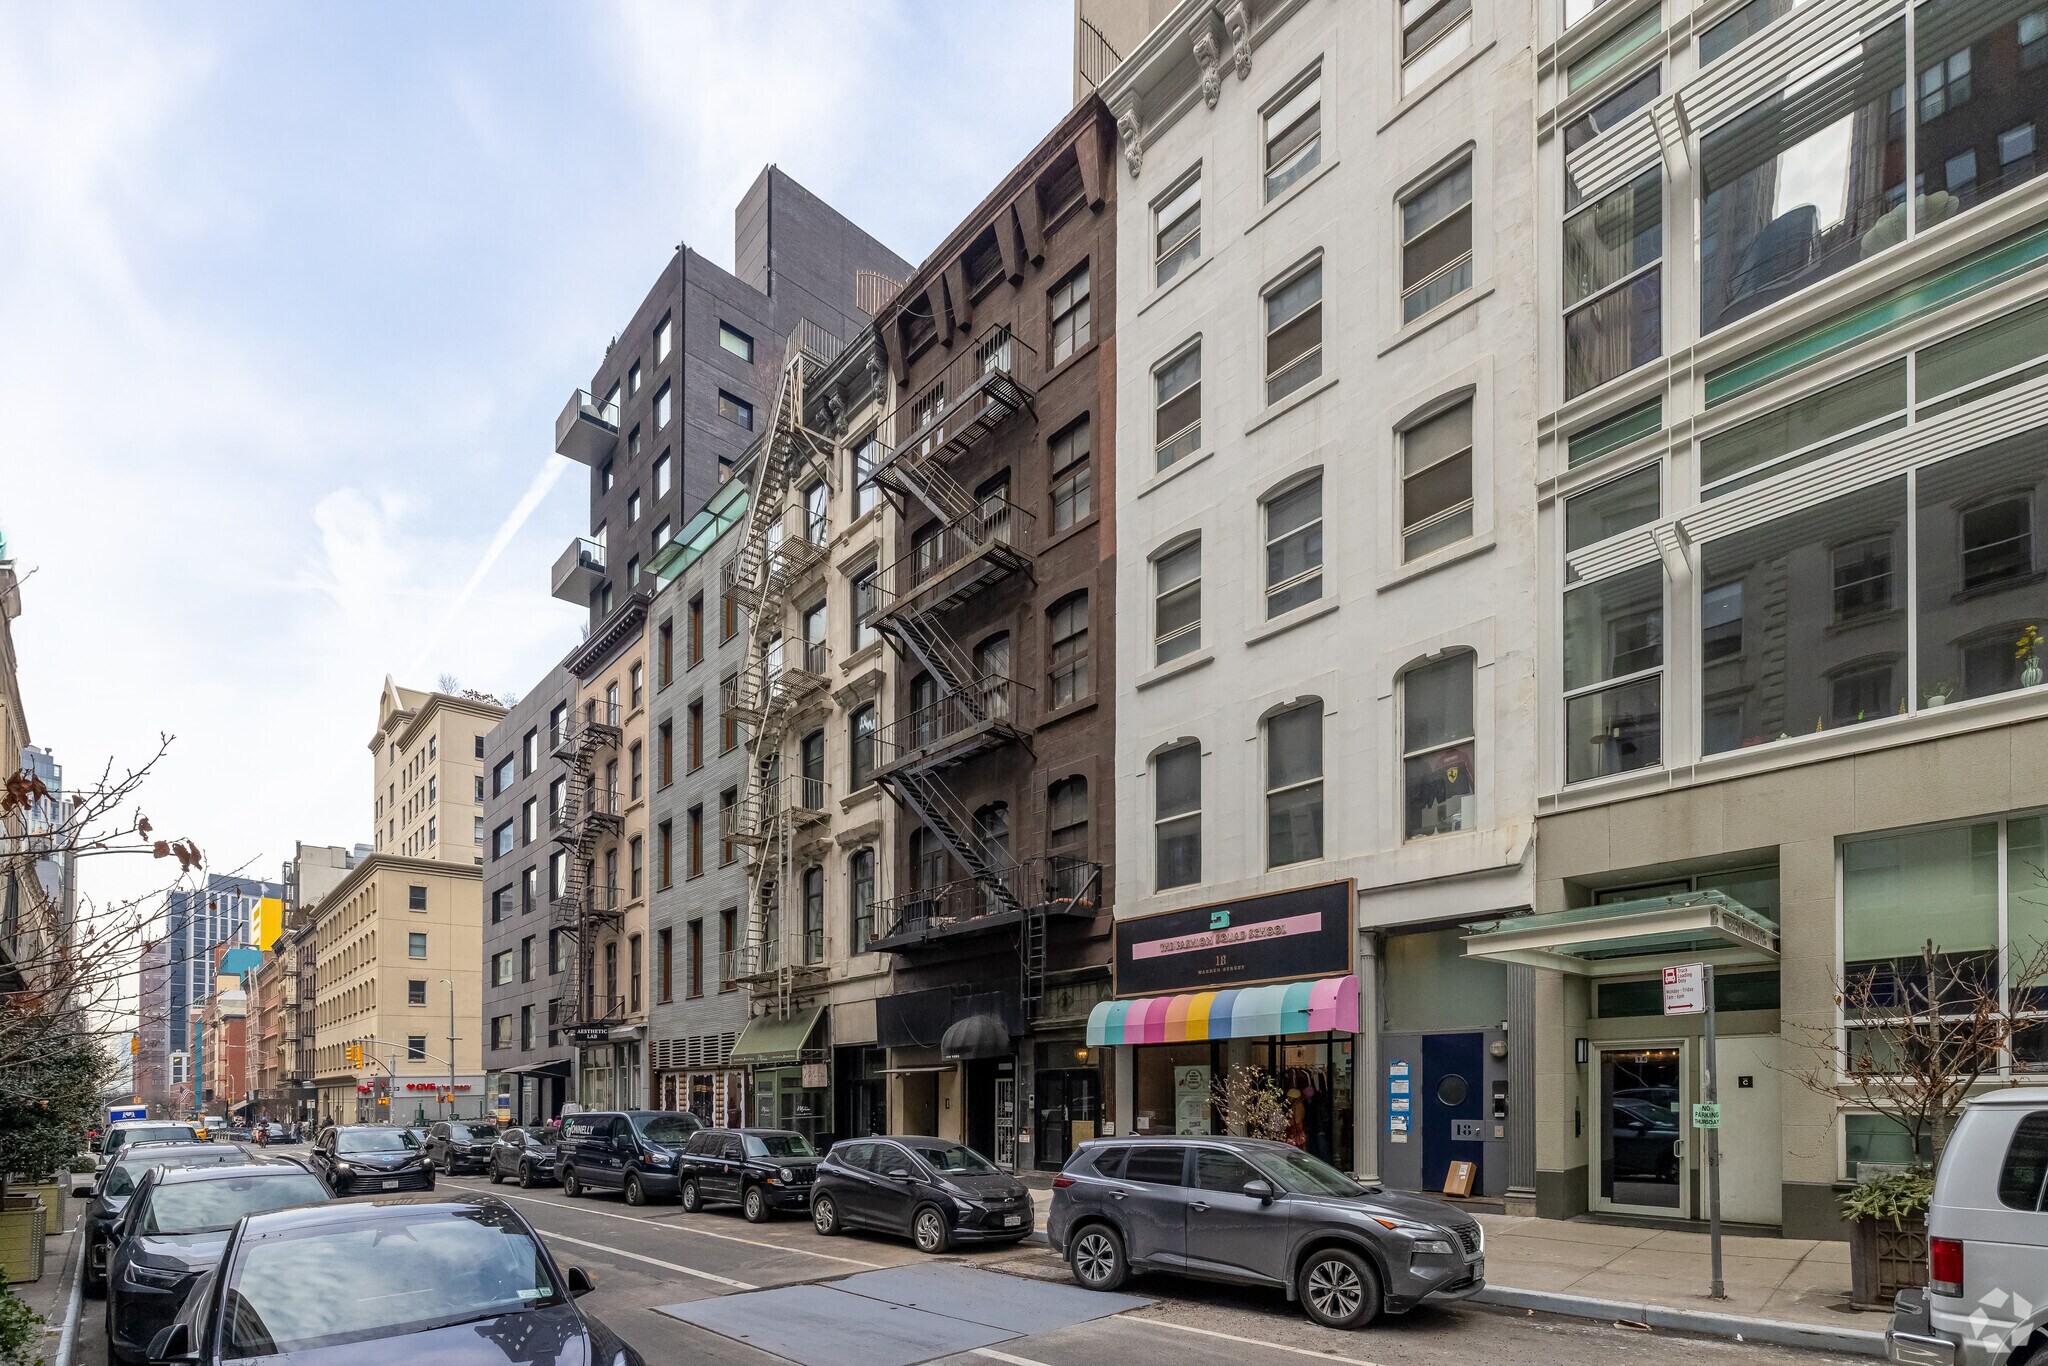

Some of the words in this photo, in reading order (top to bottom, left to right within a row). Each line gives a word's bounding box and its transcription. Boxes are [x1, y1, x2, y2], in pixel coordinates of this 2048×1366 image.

[1160, 943, 1174, 953] THE
[1176, 937, 1213, 950] FASHION
[1215, 931, 1247, 944] SQUAD
[1248, 925, 1287, 939] SCHOOL
[1216, 954, 1227, 966] 18
[415, 1082, 436, 1091] CVS
[1456, 1124, 1472, 1136] 18
